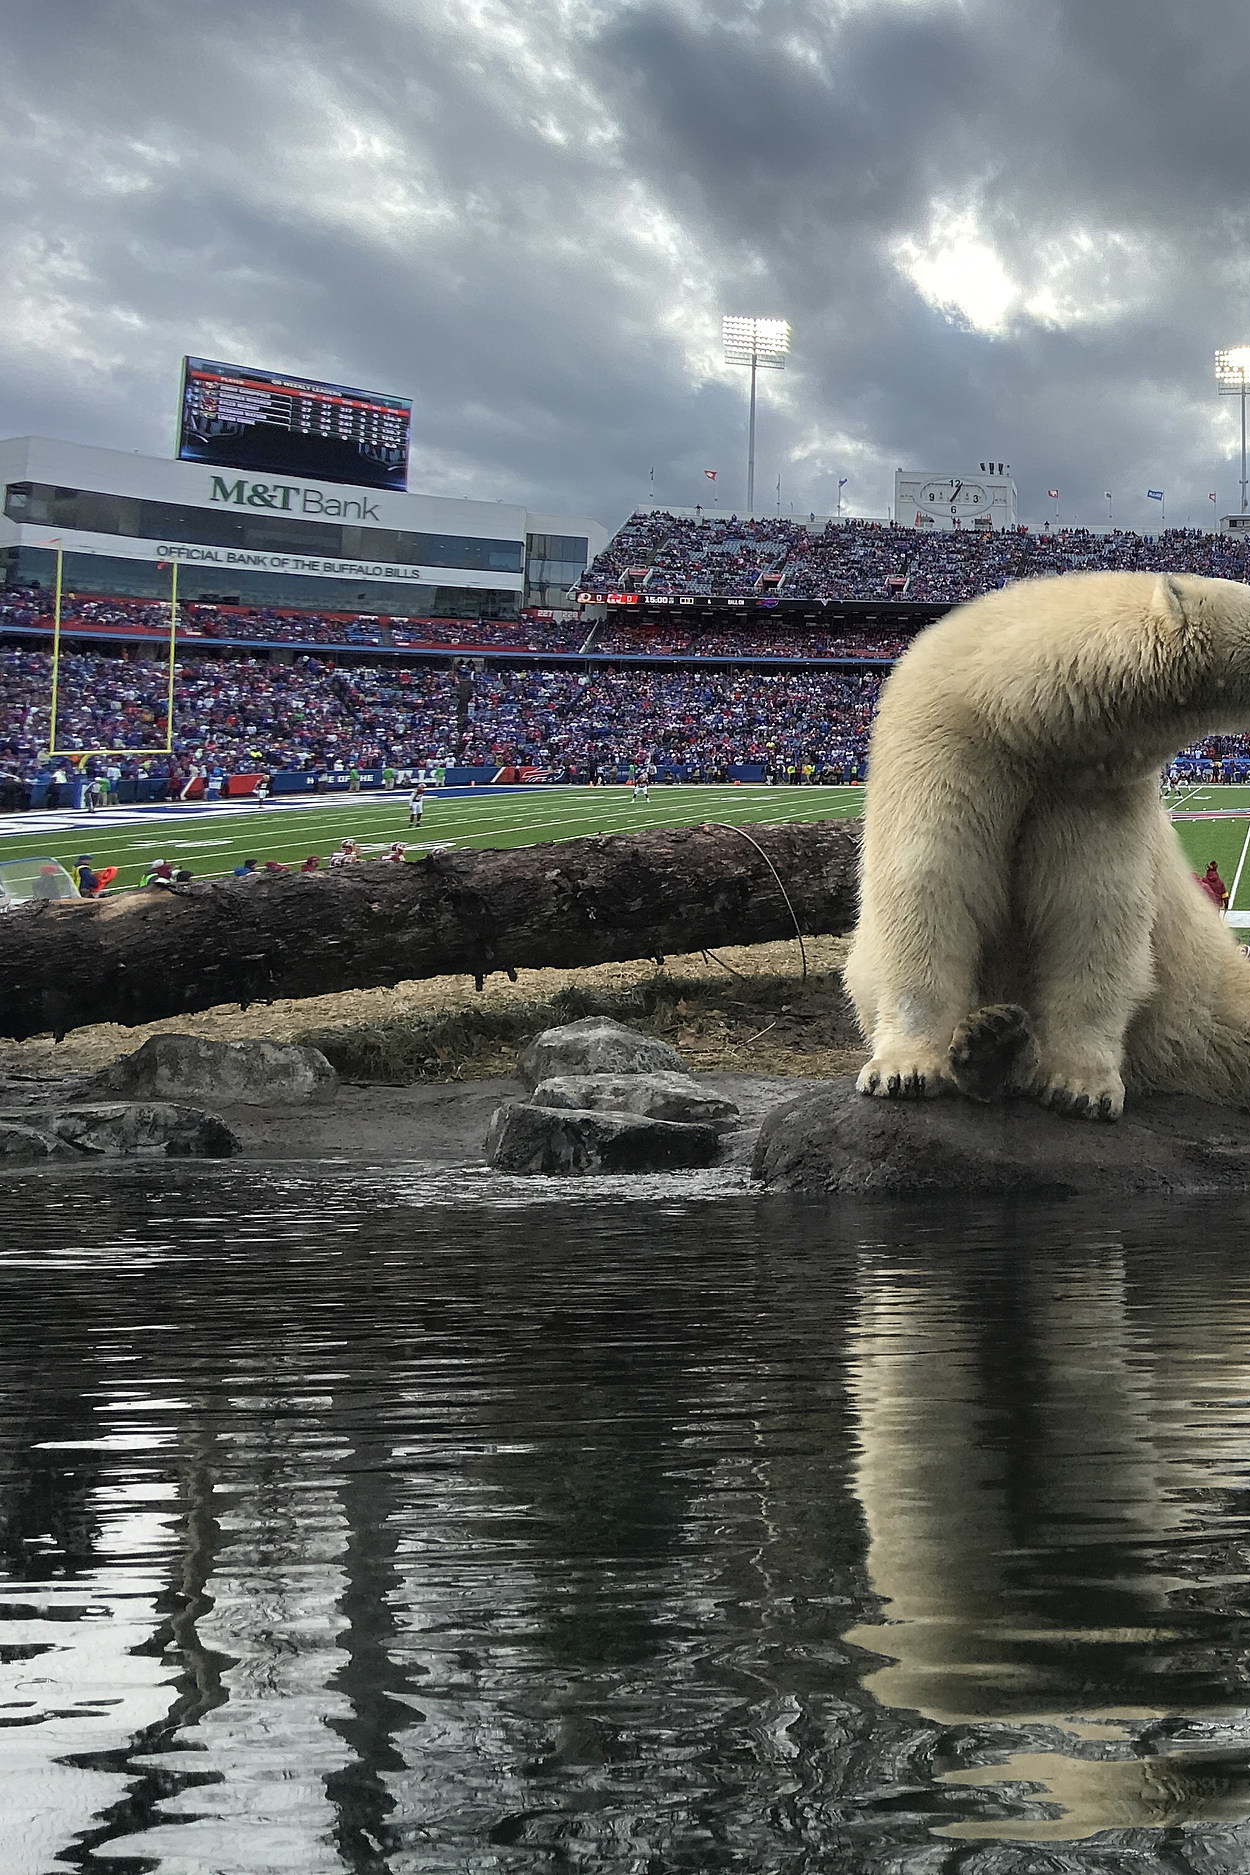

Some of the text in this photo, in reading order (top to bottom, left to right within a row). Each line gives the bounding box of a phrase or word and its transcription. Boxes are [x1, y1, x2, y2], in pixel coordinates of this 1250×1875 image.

[220, 376, 243, 385] PLAYER
[949, 480, 961, 488] 12
[210, 475, 380, 521] M&T Bank
[928, 493, 935, 501] 9
[973, 495, 979, 503] 3
[951, 505, 957, 514] 6
[156, 544, 420, 579] OFFICIAL BANK OF THE BUFFALO BILLS
[645, 595, 668, 604] 15:00
[537, 609, 553, 618] 227
